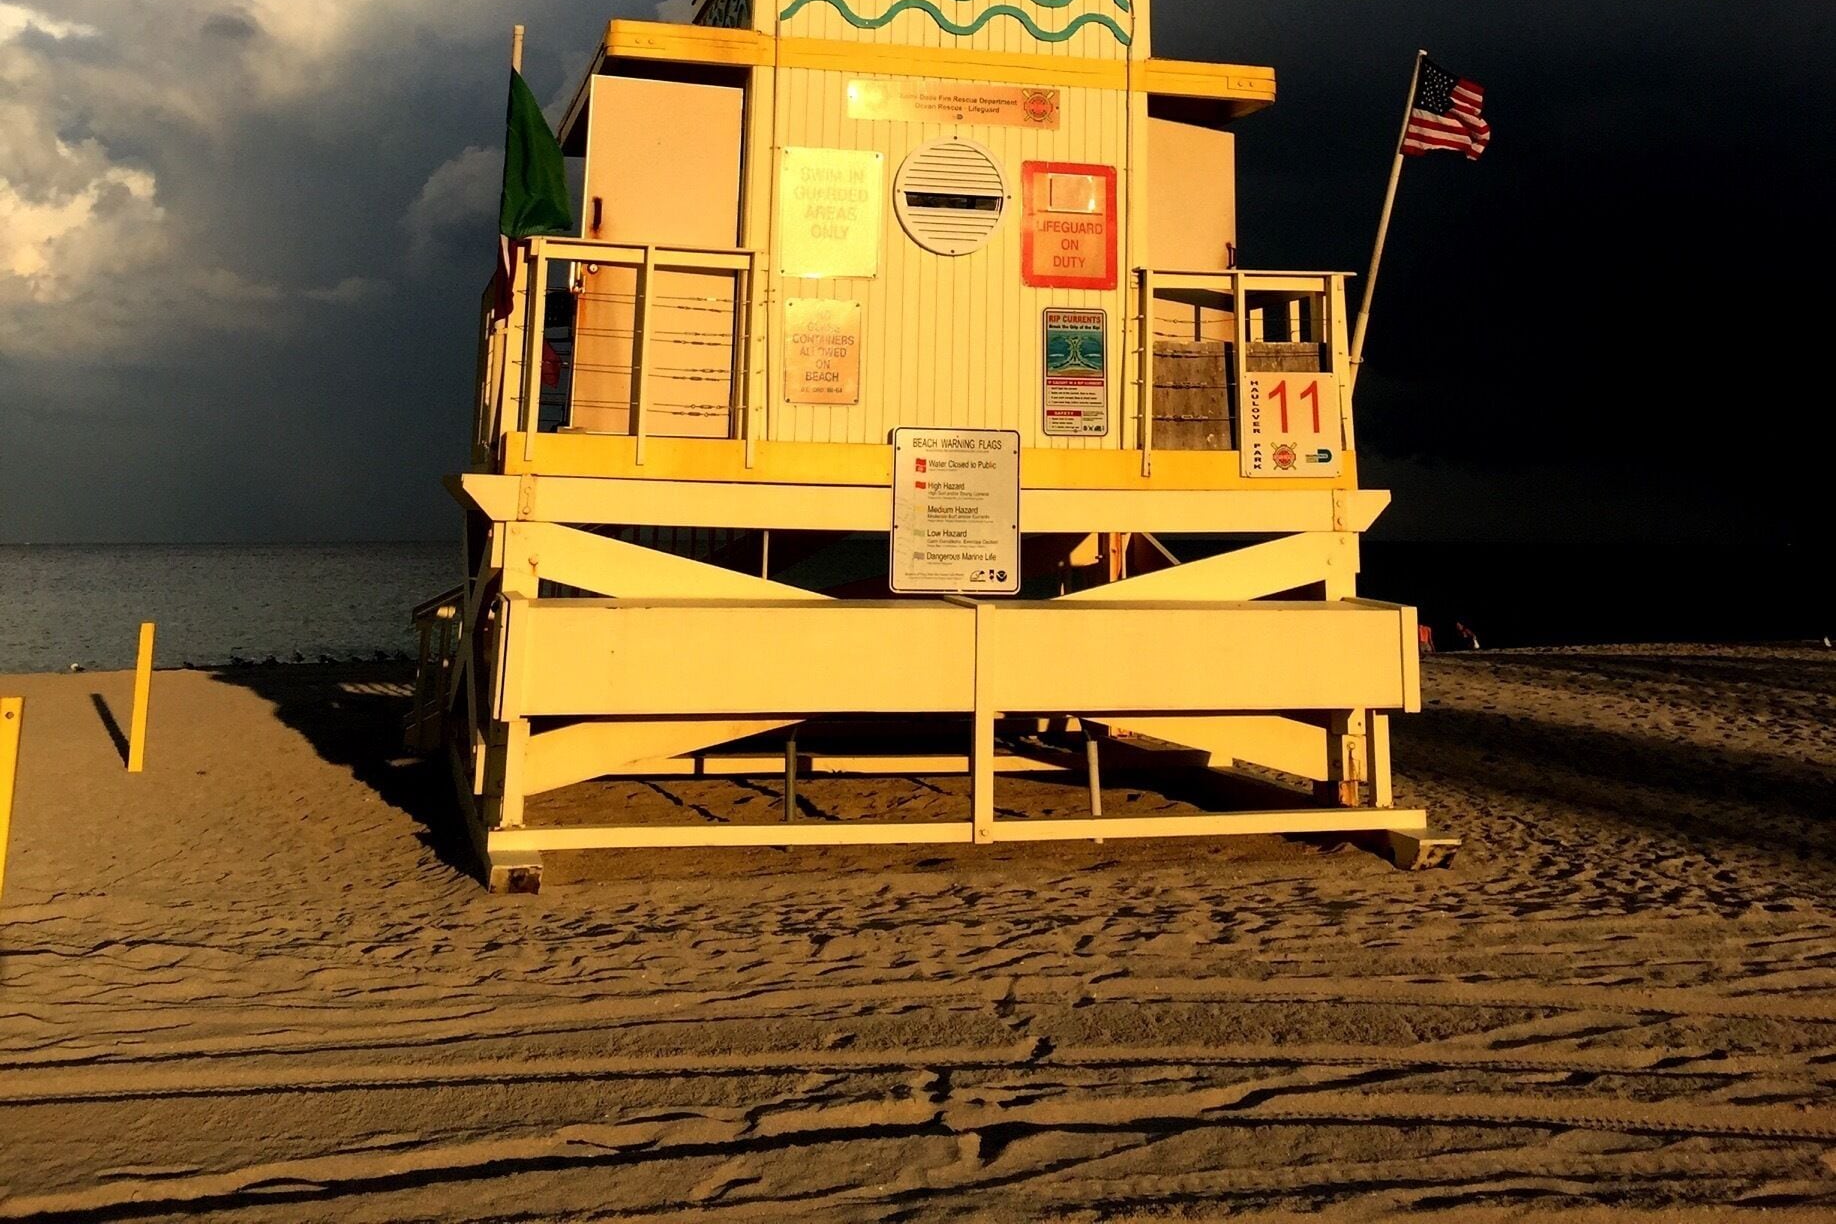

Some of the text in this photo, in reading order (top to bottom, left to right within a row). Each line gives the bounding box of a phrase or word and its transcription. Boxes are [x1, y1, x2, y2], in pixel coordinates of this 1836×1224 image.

[953, 95, 978, 104] Rescue
[979, 97, 1018, 106] Department
[938, 103, 963, 111] Rescue
[968, 105, 1000, 114] Lifeguard
[800, 165, 865, 184] SWIM IN
[793, 184, 869, 203] GUARDED
[803, 204, 858, 222] AREAS
[810, 223, 850, 240] ONLY
[1036, 220, 1104, 235] LIFEGUARD
[1060, 238, 1079, 251] ON
[1052, 255, 1086, 269] DUTY
[1048, 314, 1102, 324] RIP CURRENTS
[799, 346, 847, 358] ALOWED
[815, 358, 831, 370] ON
[805, 371, 840, 382] BEACH
[1268, 379, 1320, 434] 11
[1250, 380, 1262, 470] HAULOVER PARK
[912, 437, 1002, 451] BEACH WARNING FLAGS
[928, 459, 997, 470] Water Closed to Public
[927, 482, 965, 492] High Hazard
[927, 505, 979, 514] Medium Hazard
[926, 529, 968, 538] Low Hazard
[926, 552, 961, 564] Dangerous
[961, 552, 984, 561] Marine
[984, 552, 997, 561] Life
